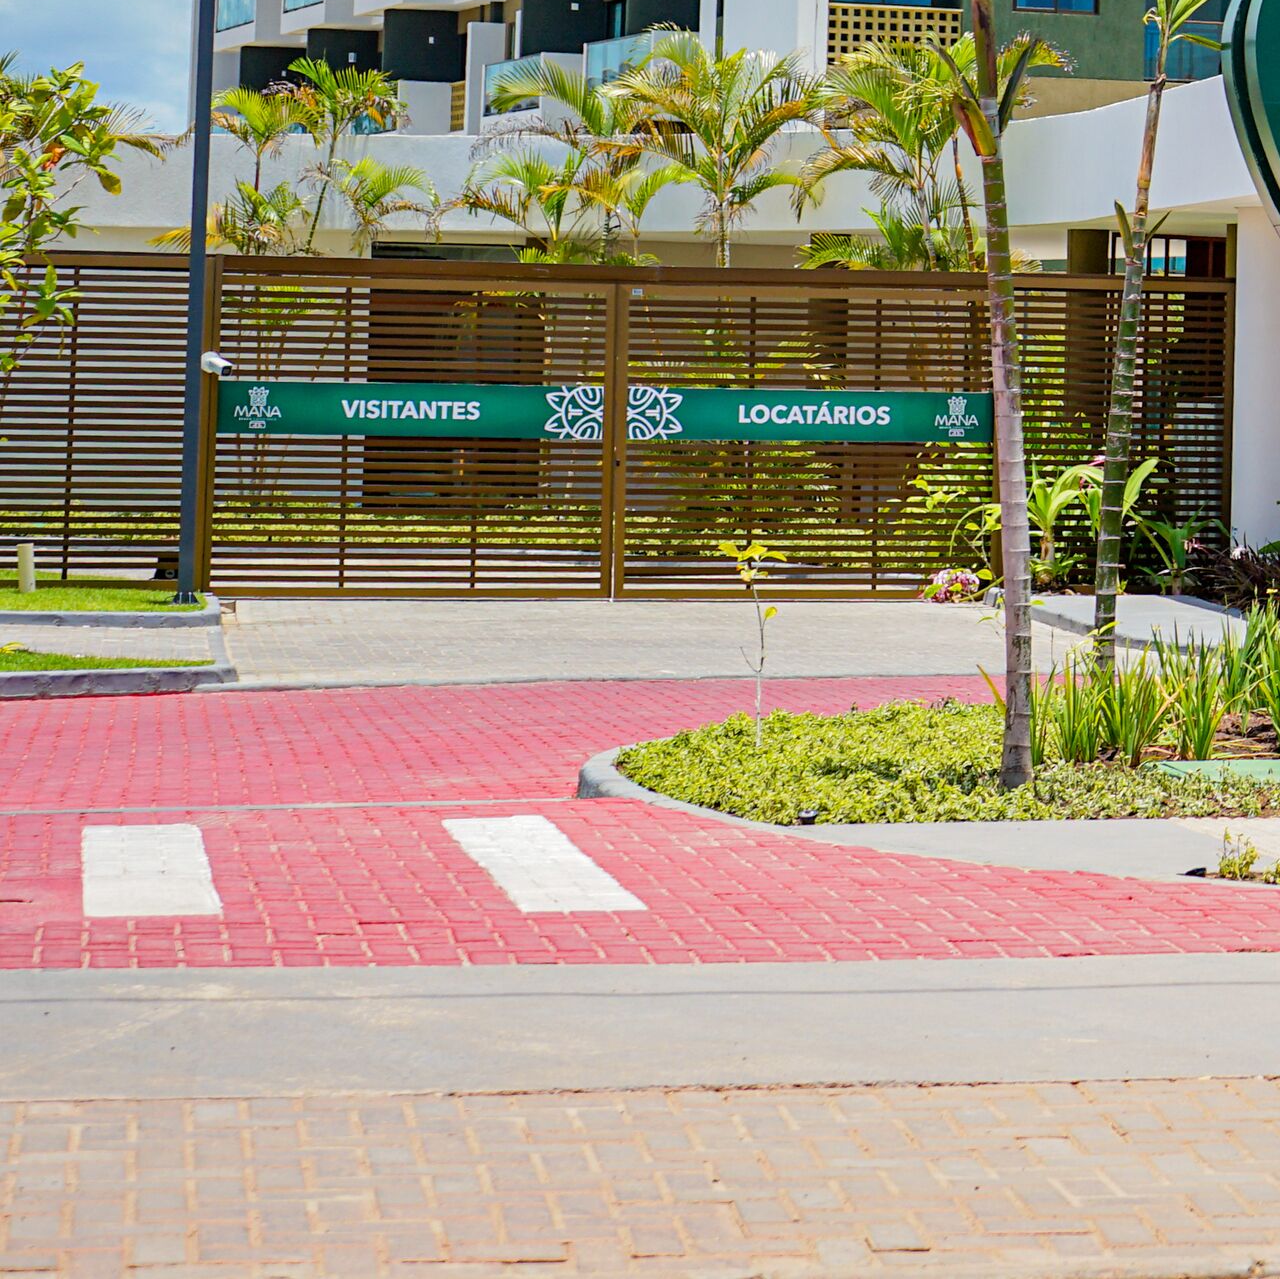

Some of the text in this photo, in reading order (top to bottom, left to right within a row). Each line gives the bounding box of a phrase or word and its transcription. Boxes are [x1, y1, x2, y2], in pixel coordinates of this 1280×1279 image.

[233, 405, 282, 418] MANA
[341, 400, 481, 421] VISITANTES
[738, 401, 891, 426] LOCATÁRIOS
[934, 414, 979, 427] MANA
